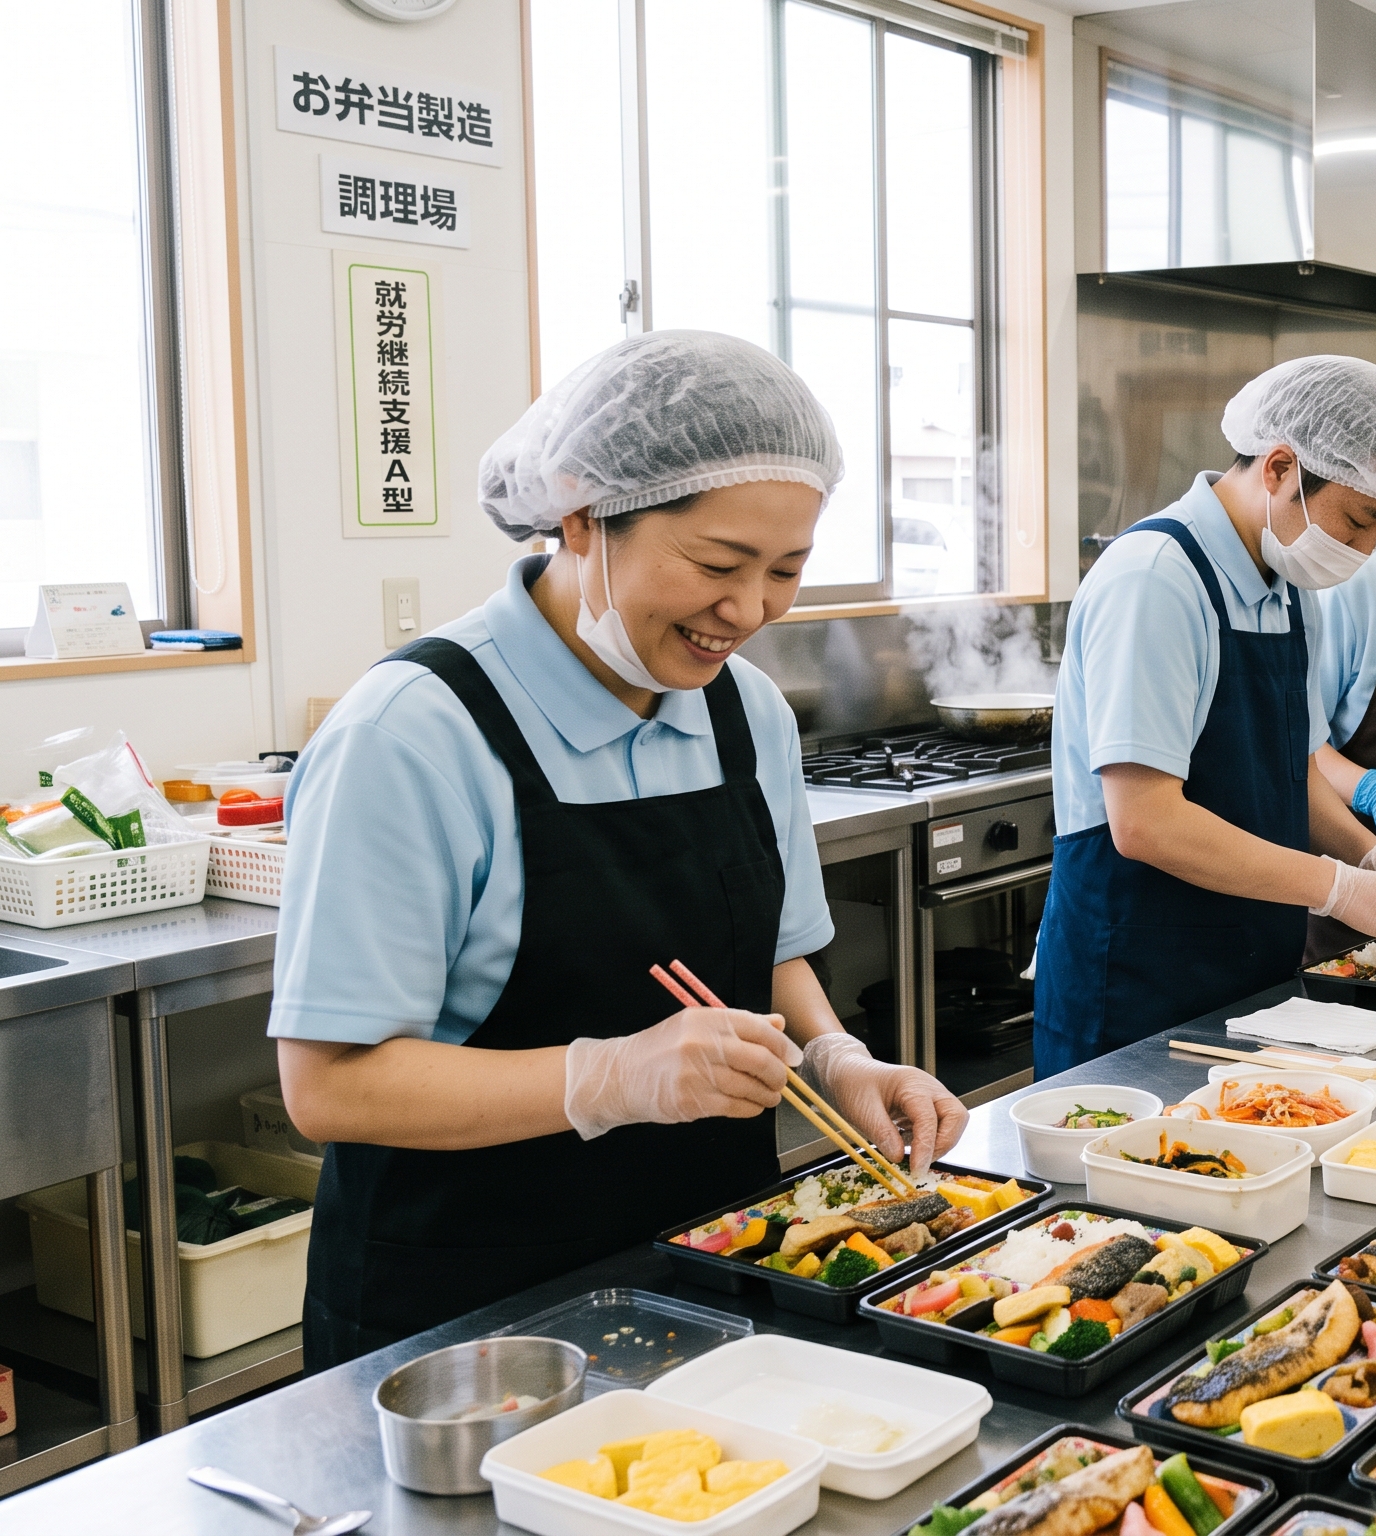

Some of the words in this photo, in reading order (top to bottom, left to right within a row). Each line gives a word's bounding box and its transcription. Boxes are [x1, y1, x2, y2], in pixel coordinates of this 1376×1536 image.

[293, 71, 493, 147] お弁当製造
[338, 173, 457, 231] 調理場
[374, 280, 414, 513] 就労継続支援A型
